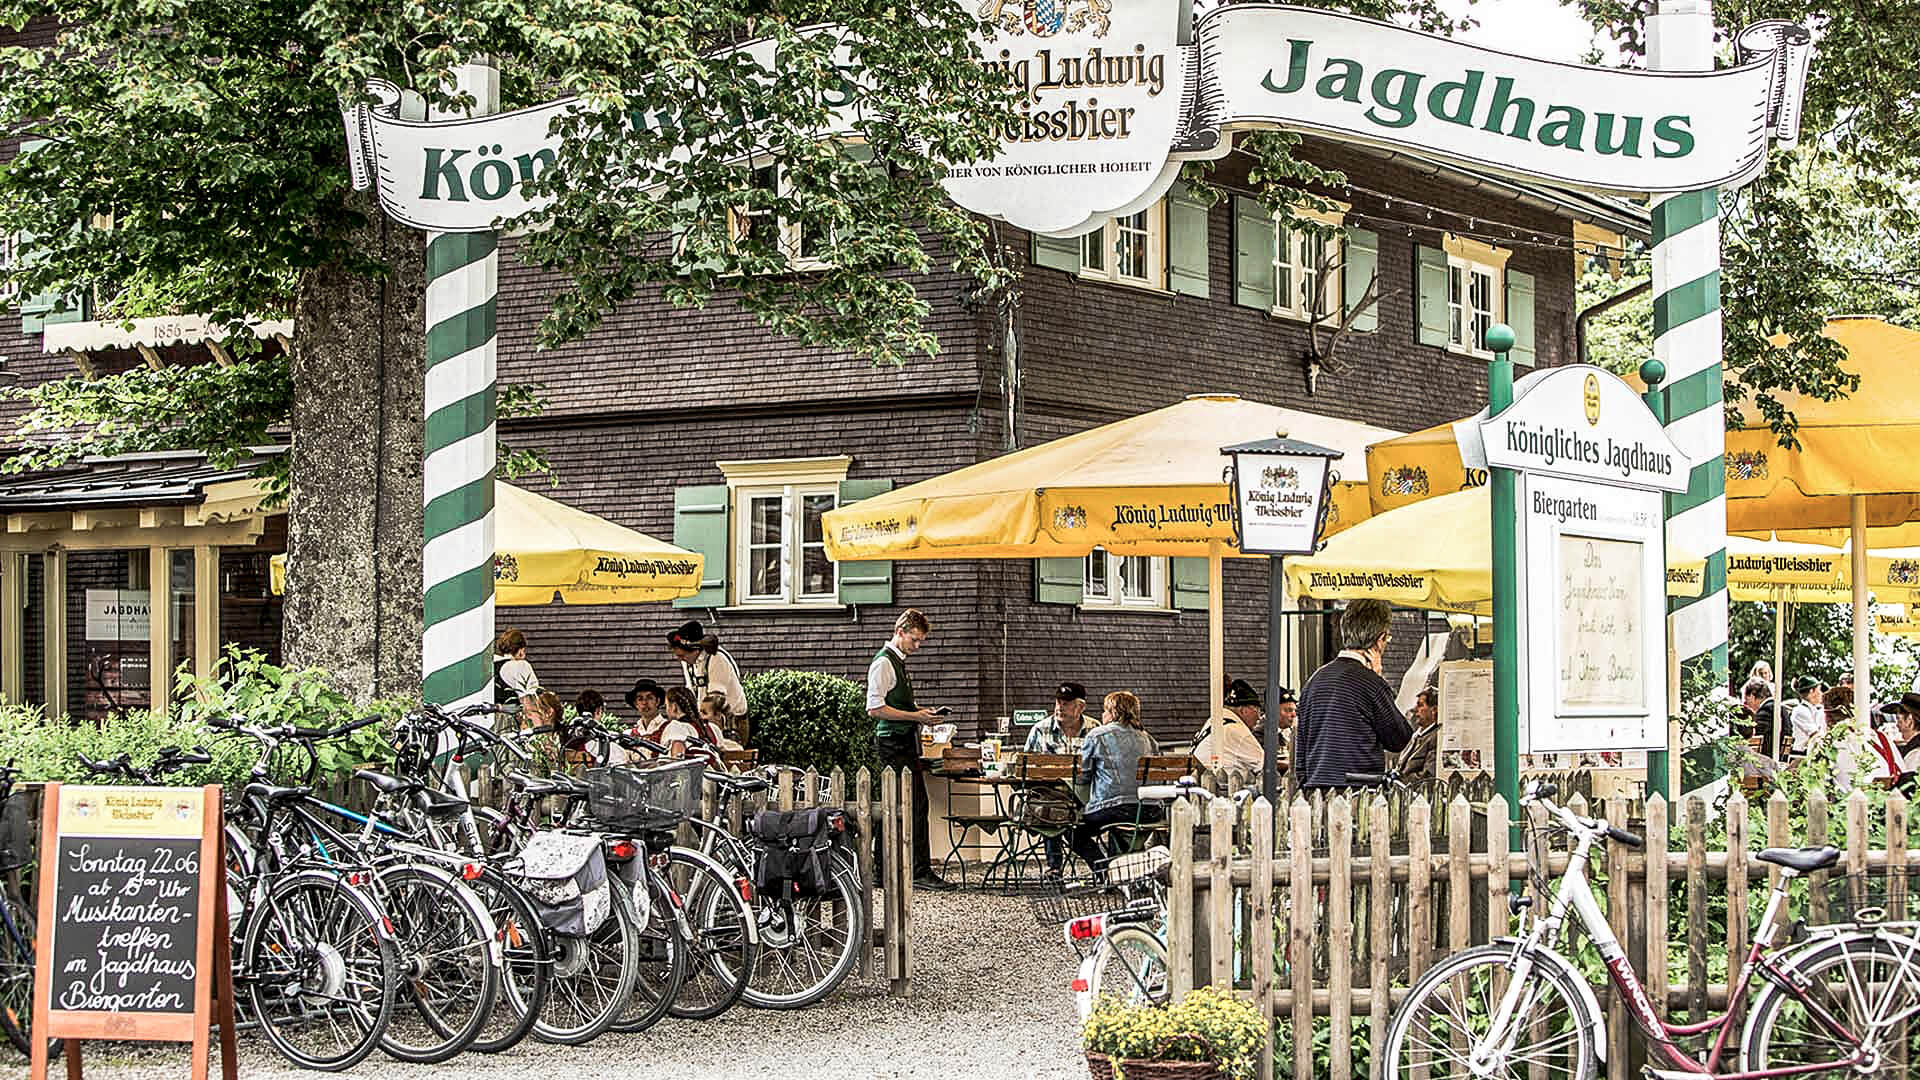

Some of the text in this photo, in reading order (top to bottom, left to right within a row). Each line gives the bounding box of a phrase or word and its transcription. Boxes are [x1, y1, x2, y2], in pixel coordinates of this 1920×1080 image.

[1032, 44, 1165, 104] Ludwig
[1260, 38, 1696, 159] Jagdhaus
[989, 98, 1135, 143] eissbier
[975, 166, 1001, 177] VON
[1005, 162, 1096, 177] KÖNIGLICHER
[1100, 161, 1151, 173] HOHEIT
[1507, 420, 1672, 477] Königliches Jagdhaus
[1111, 504, 1156, 531] König
[1157, 503, 1213, 530] Ludwig
[1533, 490, 1597, 523] Biergarten
[1728, 556, 1832, 574] Ludwig Weissbier
[1310, 572, 1424, 592] König Ludwig Weissbier
[103, 605, 151, 616] JAGDHA
[69, 844, 147, 879] Sonntag
[88, 878, 112, 895] ab
[158, 879, 191, 898] Uhr
[62, 894, 193, 923] Musikanten-
[97, 925, 173, 960] treffen
[90, 949, 196, 995] Jagdhaus
[60, 980, 184, 1013] Biergarten
